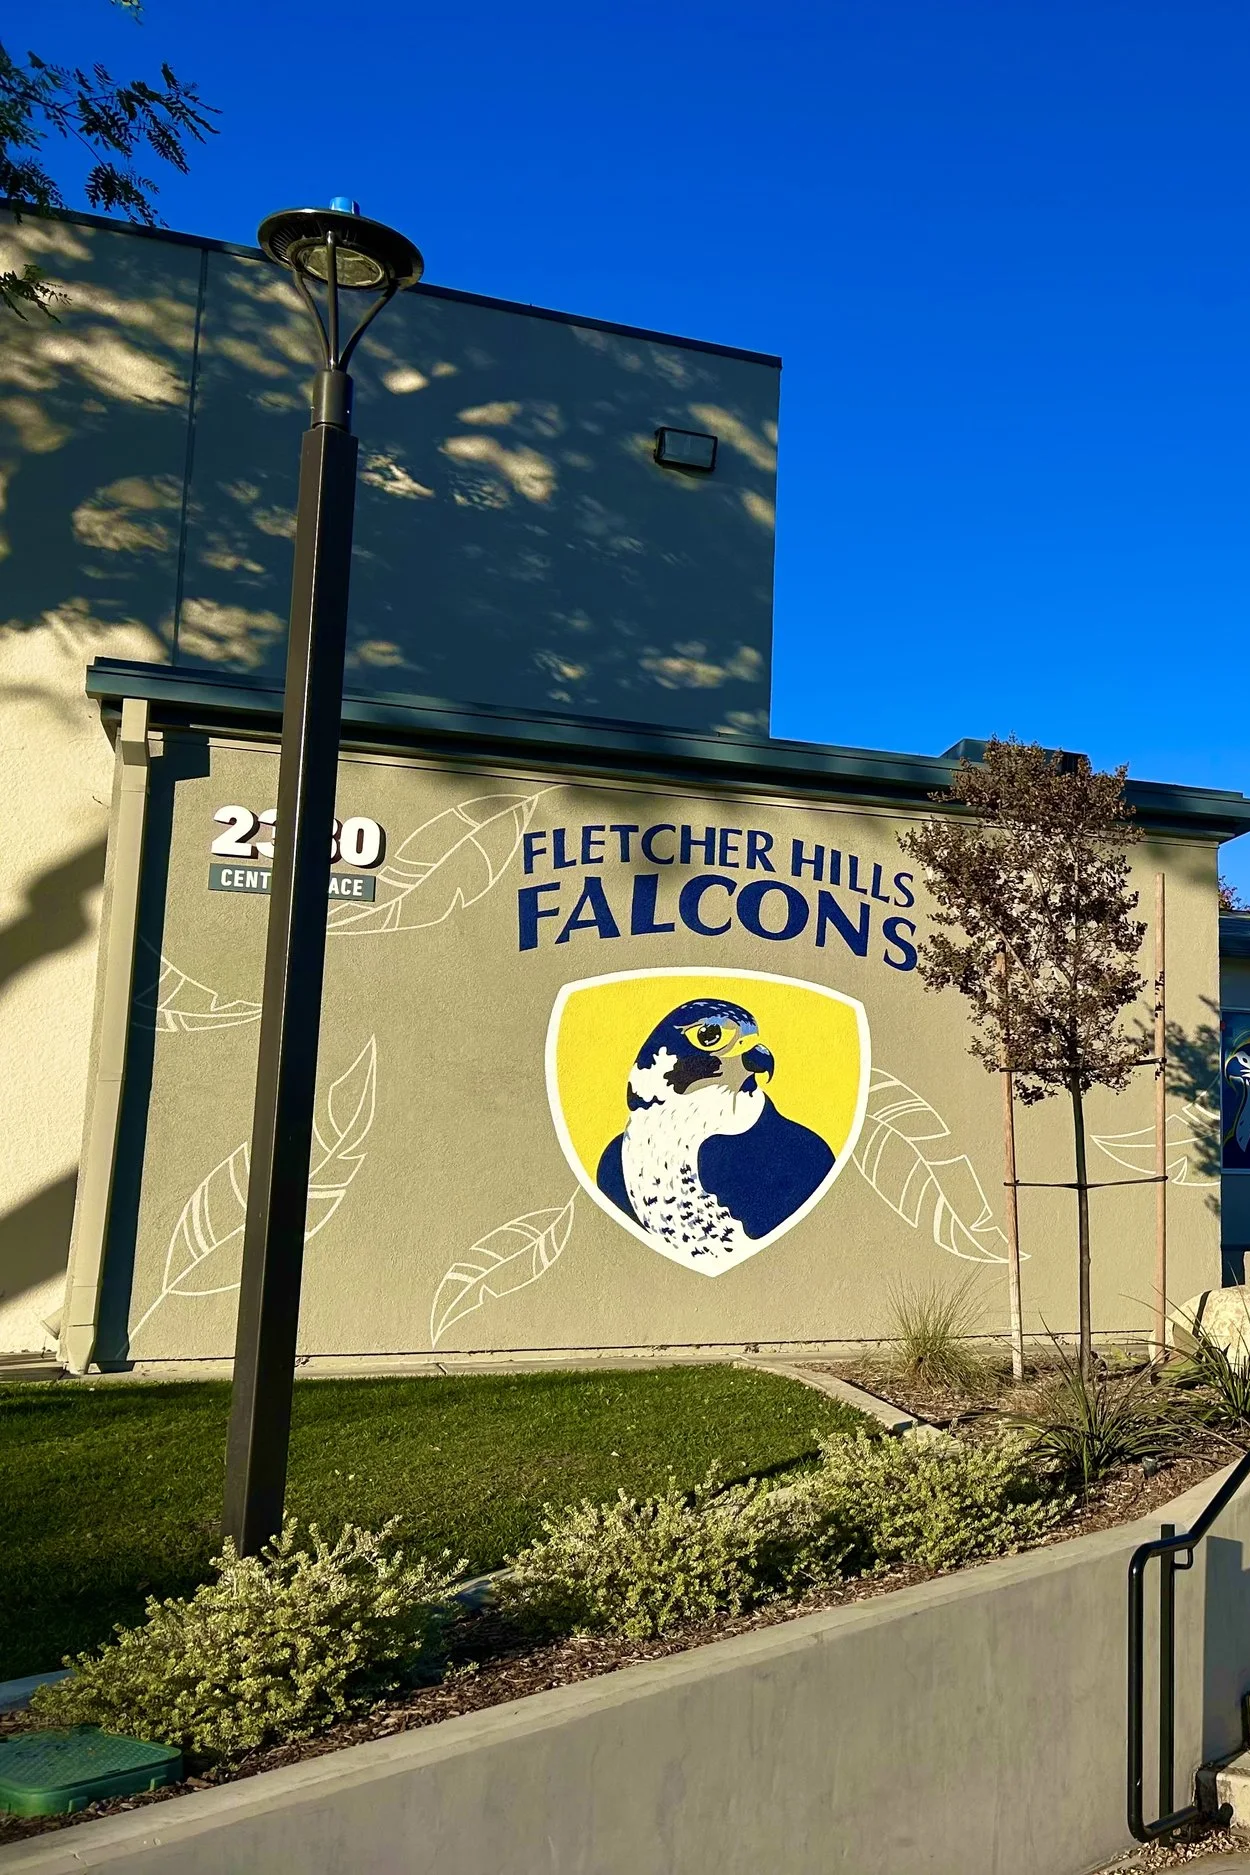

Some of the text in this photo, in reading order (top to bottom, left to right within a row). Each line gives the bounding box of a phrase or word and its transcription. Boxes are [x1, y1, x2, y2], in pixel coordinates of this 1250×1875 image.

[211, 805, 386, 868] 20
[523, 823, 916, 909] FLETCHER HILLS
[220, 868, 271, 890] CENT
[518, 873, 918, 972] FALCONS
